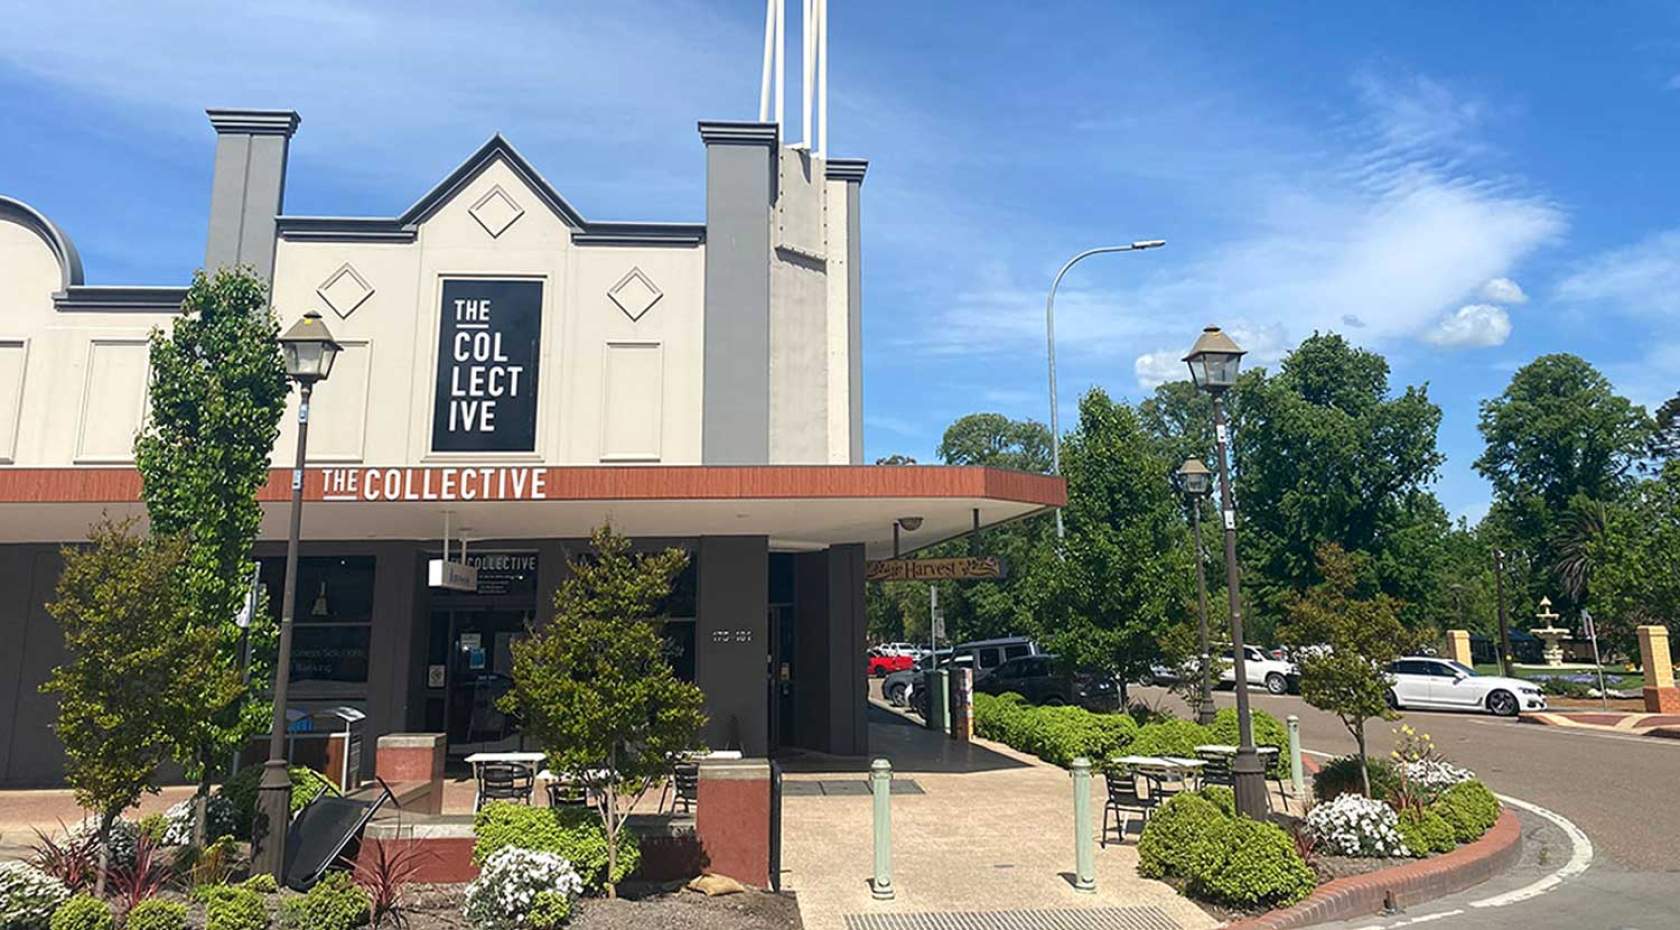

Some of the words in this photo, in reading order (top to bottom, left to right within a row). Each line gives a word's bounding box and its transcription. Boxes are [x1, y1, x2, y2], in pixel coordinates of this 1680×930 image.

[454, 300, 491, 321] THE
[453, 331, 508, 362] COL
[451, 366, 523, 397] LECT
[449, 401, 496, 432] IVE
[322, 469, 359, 492] THE
[364, 468, 548, 501] COLLECTIVE
[904, 561, 956, 579] Harvest
